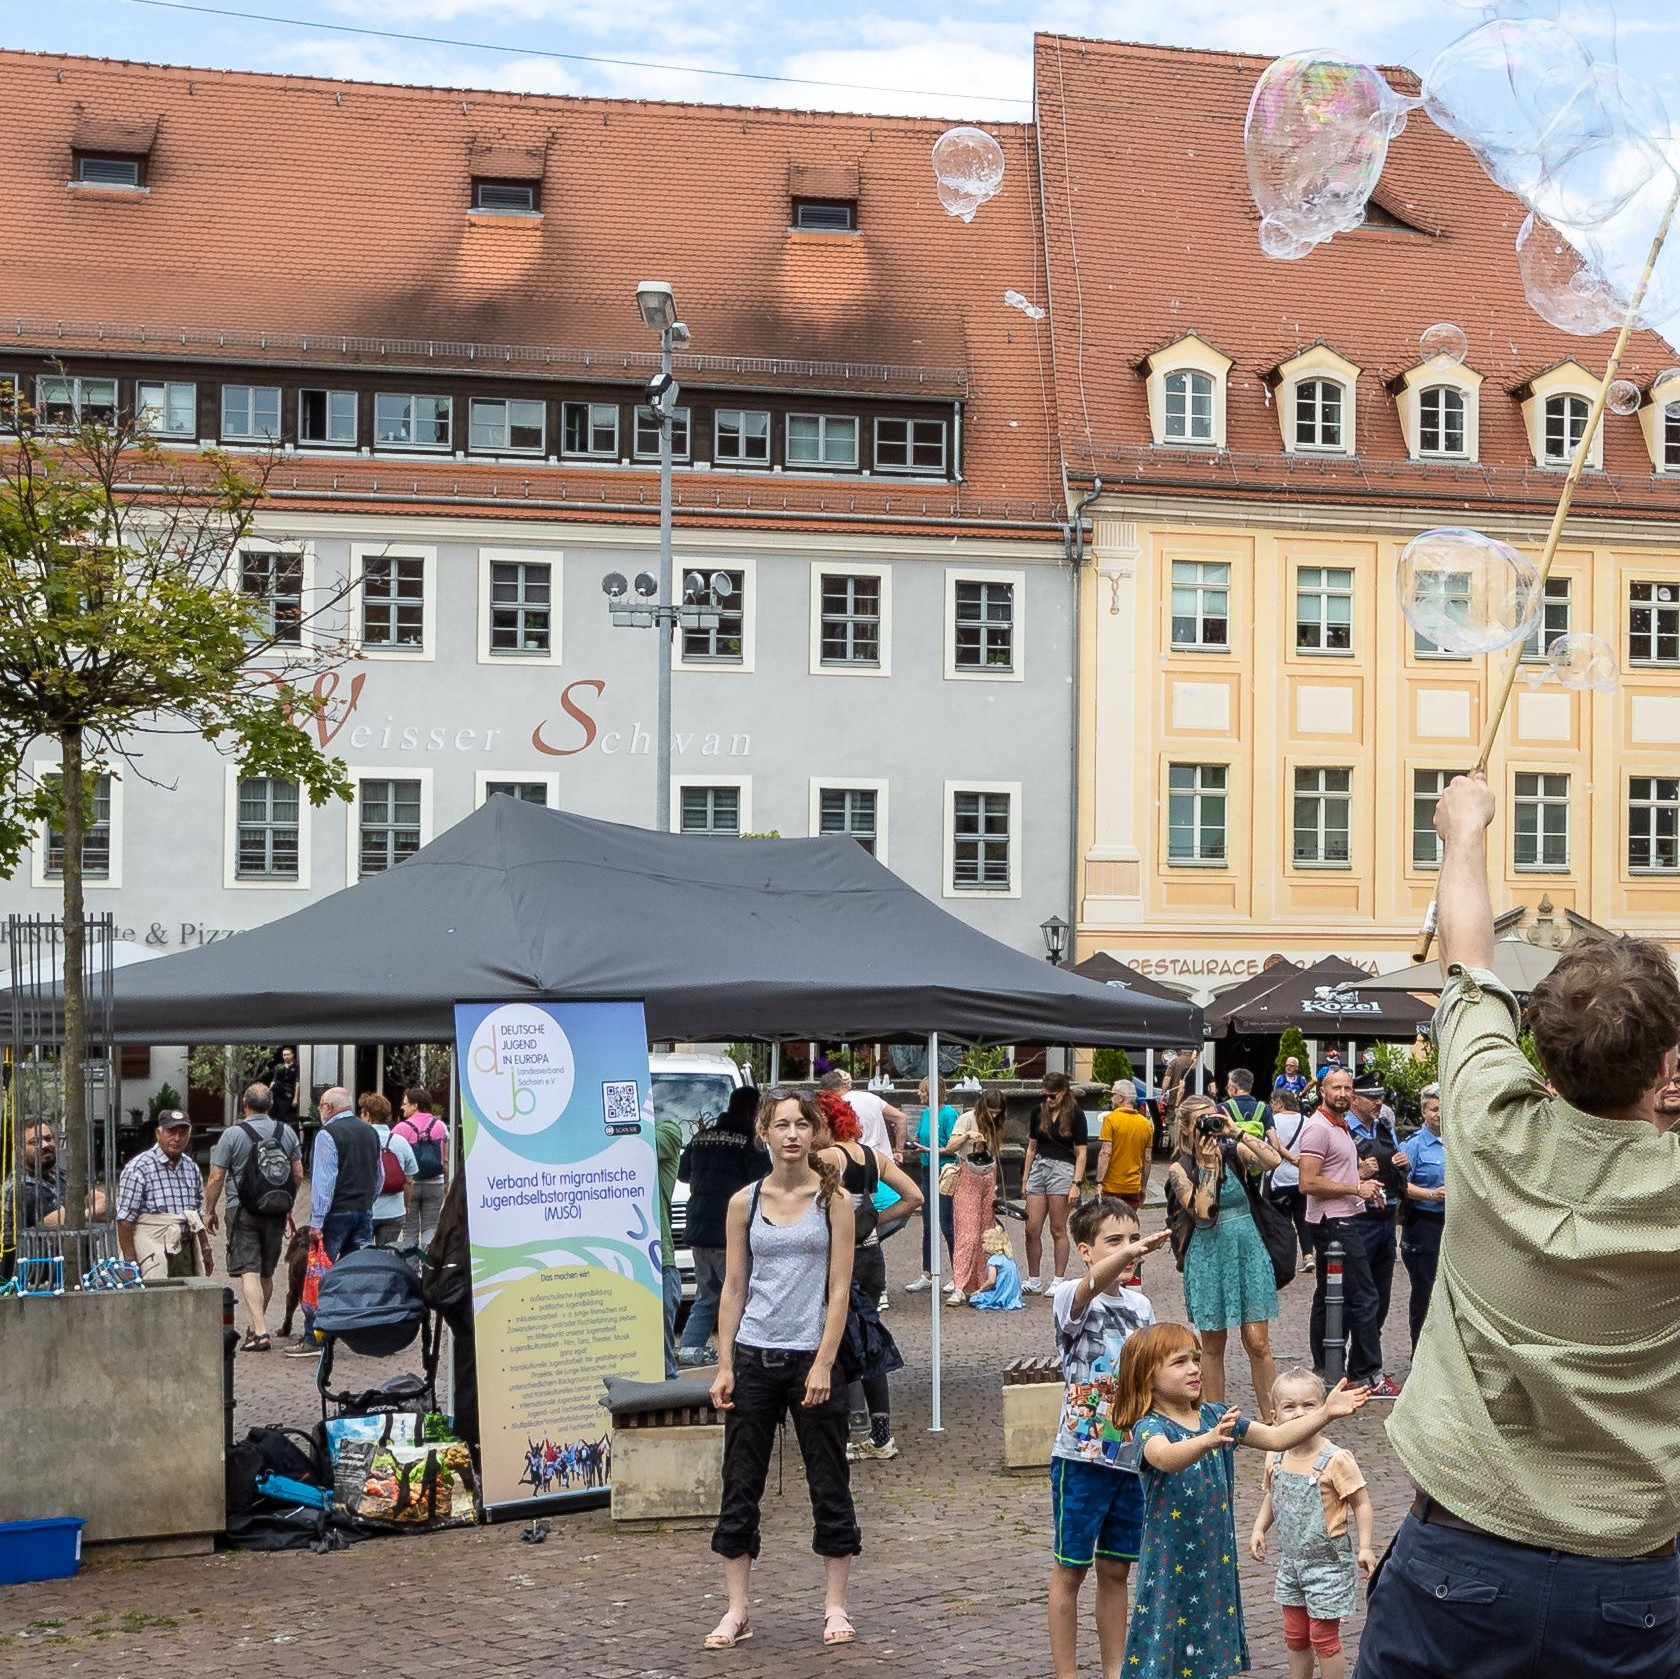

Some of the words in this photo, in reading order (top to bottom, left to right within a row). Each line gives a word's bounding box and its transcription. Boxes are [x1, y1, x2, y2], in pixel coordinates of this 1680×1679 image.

[235, 670, 501, 751] Weisser
[531, 678, 753, 757] Schwan
[0, 920, 135, 945] Ristoante
[145, 922, 169, 945] &
[179, 922, 244, 945] Pizz
[1128, 958, 1260, 976] RESTAURACE
[1301, 999, 1383, 1015] Kozel
[500, 1023, 545, 1036] DEUTSCHE
[501, 1039, 538, 1051] JUGEND
[502, 1055, 513, 1065] IN
[514, 1053, 549, 1065] EUROPA
[517, 1066, 565, 1077] Landesverband
[517, 1078, 544, 1087] Sachsen
[487, 1172, 538, 1190] Verband
[541, 1171, 556, 1186] für
[559, 1166, 637, 1188] migrantische
[479, 1184, 645, 1212] Jugendselbstorganisationen
[544, 1204, 582, 1222] (MJSO)
